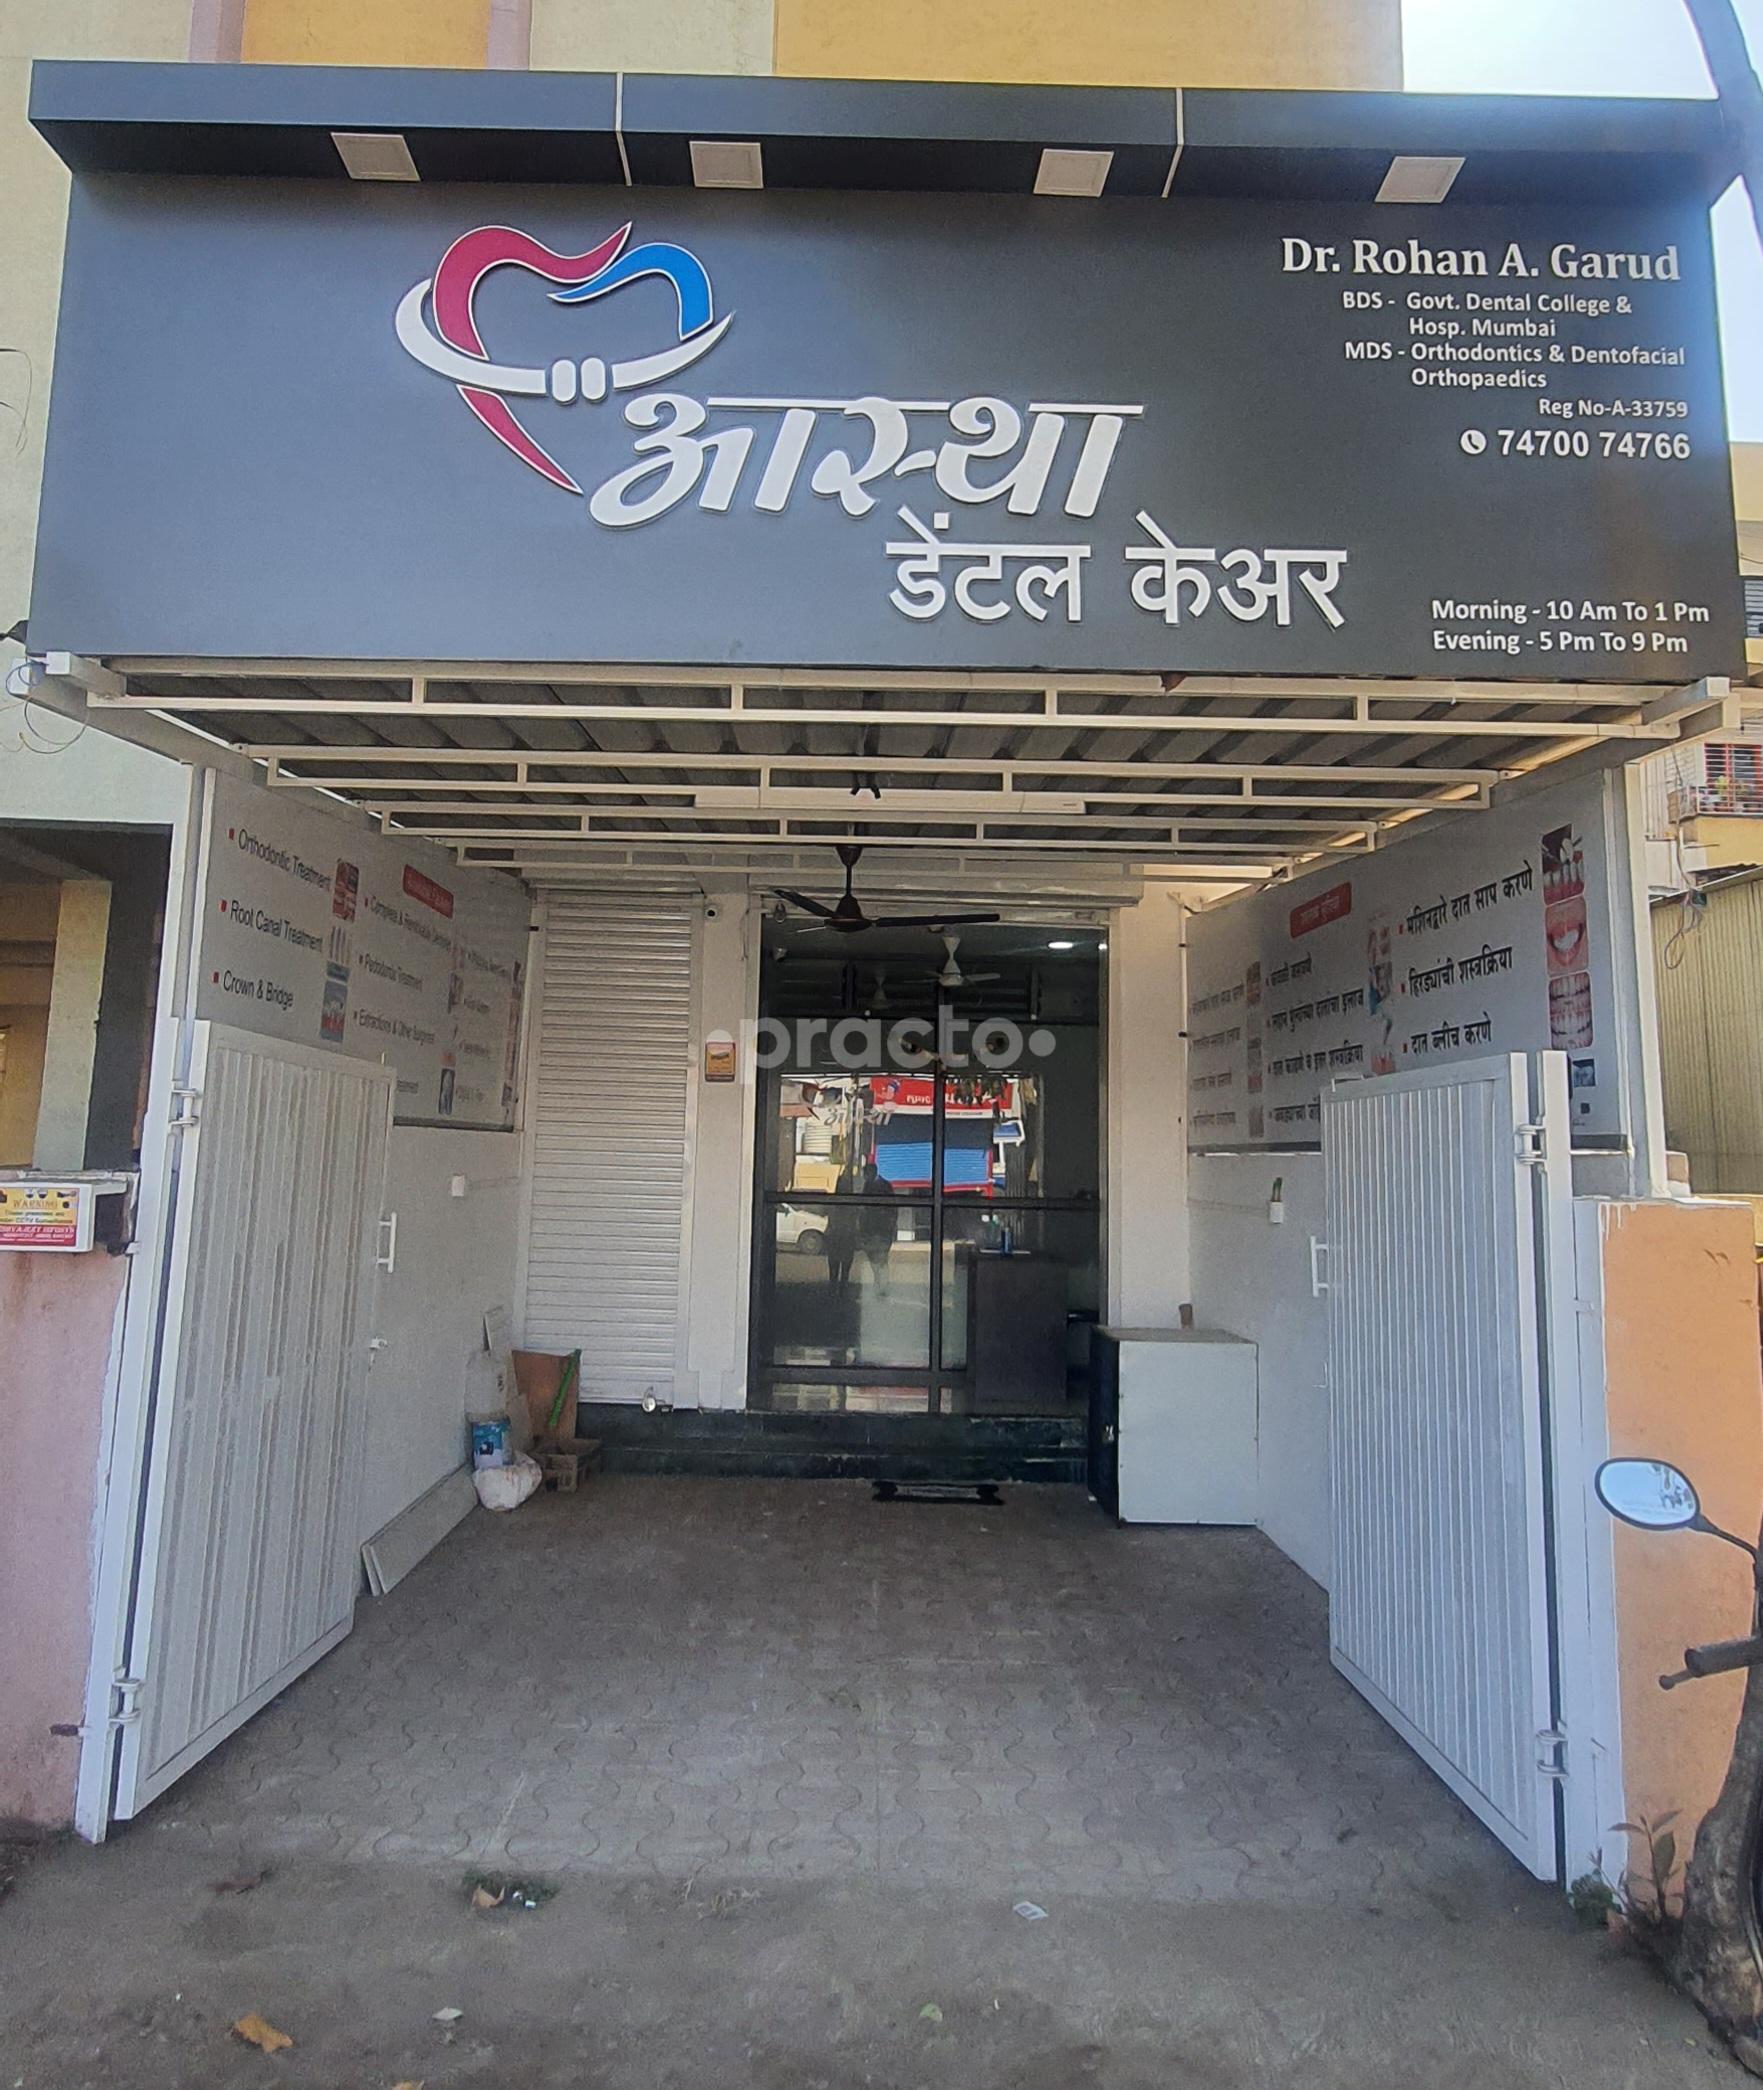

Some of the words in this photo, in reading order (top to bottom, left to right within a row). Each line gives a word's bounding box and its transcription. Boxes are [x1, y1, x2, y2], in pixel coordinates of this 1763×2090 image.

[1281, 237, 1341, 273] Dr.
[1352, 239, 1488, 276] Rohan
[1499, 243, 1539, 278] A.
[1550, 244, 1681, 281] Garud
[1342, 292, 1383, 309] BDS
[1406, 293, 1460, 310] Govt.
[1466, 293, 1531, 312] Dental
[1537, 294, 1611, 317] College
[1615, 296, 1632, 313] &
[1409, 317, 1466, 339] Hosp.
[1472, 318, 1556, 337] Mumbai
[1345, 342, 1392, 360] MDS
[1411, 343, 1542, 363] Orthodontics
[1548, 345, 1565, 363] &
[1571, 345, 1685, 366] Dentofacial
[1411, 368, 1547, 390] Orthopaedics
[1539, 399, 1573, 418] Reg
[1578, 399, 1688, 418] No-A-33759
[589, 393, 1143, 528] आस्था
[1498, 429, 1590, 457] 74700
[1599, 432, 1691, 459] 74766
[886, 505, 1091, 623] डेंटल
[1125, 510, 1347, 630] केअर
[1431, 599, 1527, 624] Morning
[1546, 600, 1573, 620] 10
[1580, 601, 1617, 621] Am
[1622, 602, 1648, 621] To
[1654, 602, 1667, 622] 1
[1674, 603, 1710, 622] Pm
[1433, 630, 1520, 654] Evening
[1539, 631, 1552, 651] 5
[1559, 632, 1595, 651] Pm
[1600, 632, 1626, 651] To
[1632, 632, 1645, 652] 9
[1652, 632, 1688, 652] Pm
[238, 829, 290, 872] Orthodontic
[293, 855, 331, 892] Treatment
[1451, 893, 1470, 921] दात
[1502, 860, 1532, 898] करणे
[230, 900, 254, 927] Root
[255, 910, 282, 937] Canal
[284, 921, 323, 952] Treatment
[223, 970, 255, 998] Crown
[256, 979, 264, 999] &
[266, 982, 294, 1011] Bridge
[1411, 1033, 1427, 1055] दात
[1463, 1011, 1491, 1044] करणे
